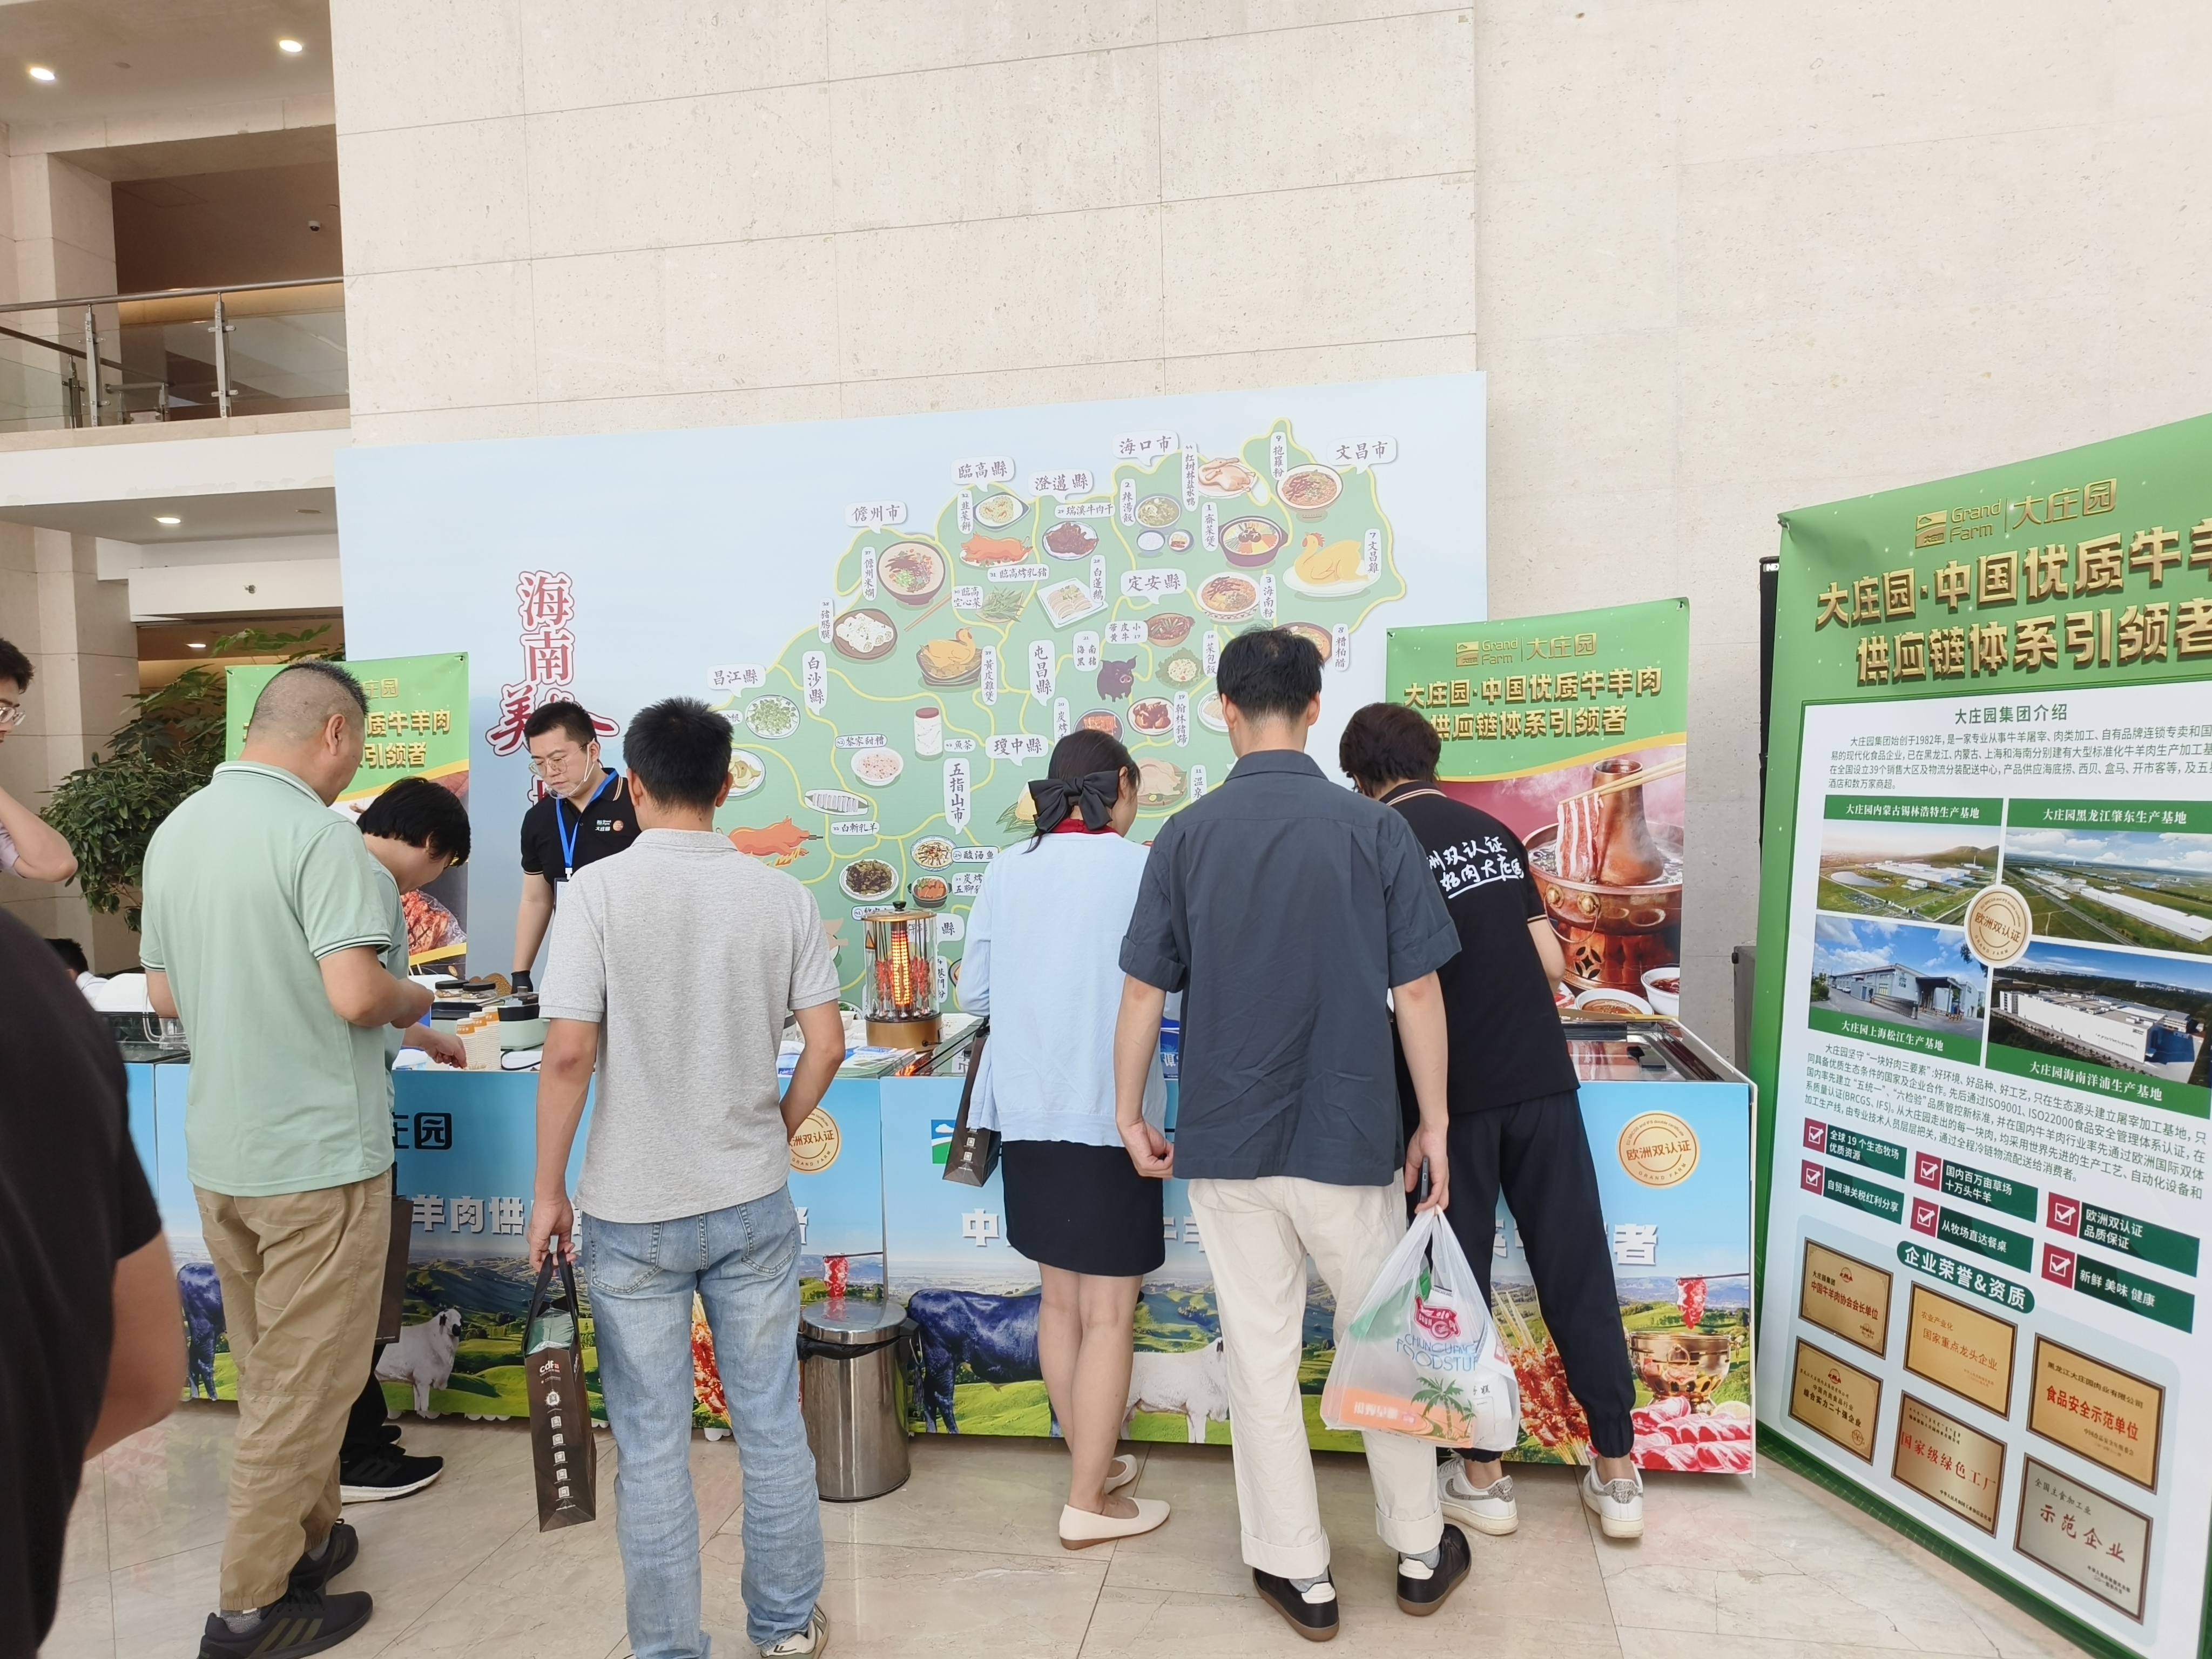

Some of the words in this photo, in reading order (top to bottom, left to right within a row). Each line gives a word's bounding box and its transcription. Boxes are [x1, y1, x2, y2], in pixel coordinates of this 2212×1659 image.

[1118, 436, 1172, 454] 海口市
[1336, 441, 1388, 461] 文昌市
[958, 460, 1008, 480] 臨高縣
[1273, 444, 1286, 478] 抱羅粉
[1184, 453, 1196, 507] 红树林盐水鸭
[851, 504, 901, 524] 儋州市
[1066, 504, 1114, 517] 瑞溪牛肉干
[1122, 491, 1135, 524] 辣湯飯
[1951, 497, 2001, 524] Grand
[2012, 477, 2118, 530] 大庄园
[1950, 523, 1993, 543] Farm
[1367, 542, 1380, 574] 文昌雞
[1128, 573, 1181, 592] 定安縣
[953, 597, 981, 609] 空心菜
[1262, 585, 1274, 619] 海南粉
[522, 576, 570, 682] 海南
[1076, 644, 1097, 656] 海南
[1335, 636, 1347, 669] 糟粕醋
[1481, 637, 1518, 652] Grand
[1526, 632, 1597, 661] 大庄园
[1034, 645, 1052, 696] 屯昌縣
[1481, 654, 1513, 665] Farm
[713, 669, 758, 685] 昌江縣
[807, 656, 825, 704] 白沙縣
[1403, 666, 1662, 709] 大庄园·中国优质牛羊肉
[1954, 703, 2068, 725] 大庄园集团介绍
[359, 741, 427, 767] 引领者
[954, 739, 973, 751] 魚茶
[994, 736, 1042, 756] 瓊中縣
[949, 763, 965, 823] 五指山市
[1828, 778, 1896, 790] 酒店和数万家商超。
[1845, 803, 1980, 819] 大庄园内蒙古锡林浩特生产基地
[2042, 808, 2188, 826] 大庄园黑龙江肇东生产基地
[963, 851, 994, 860] 酸汤鱼
[962, 873, 982, 884] 炭烤
[1974, 912, 2021, 943] 欧洲双认证
[1974, 934, 1990, 954] GRAND
[1841, 1020, 1944, 1051] 大庄园上海松江生产基地
[2029, 1061, 2163, 1102] 大庄园海南洋浦生产基地
[789, 1130, 835, 1147] 洲双认证
[1626, 1139, 1691, 1161] 欧洲双认证
[1829, 1142, 1861, 1162] 优质资源
[1830, 1129, 1846, 1143] 全球
[1847, 1135, 1857, 1145] 19
[1858, 1139, 1899, 1160] 个生态牧场
[791, 1157, 814, 1166] GRAND
[817, 1150, 831, 1164] FARM
[1638, 1171, 1665, 1181] GRAND
[1669, 1163, 1687, 1178] FARM
[1945, 1165, 2013, 1196] 国内百万亩草场
[1945, 1182, 1992, 1204] 十万头牛羊
[1826, 1179, 1899, 1213] 自贸港关税红利分享
[962, 1208, 1000, 1247] 中
[1941, 1219, 2007, 1253] 从牧场直达餐桌
[2085, 1209, 2143, 1238] 欧洲双认证
[1613, 1223, 1658, 1266] 者
[2083, 1226, 2130, 1251] 品质保证
[1812, 1270, 1836, 1287] 大庄园集团
[1904, 1245, 2027, 1311] 企业荣誉&资质
[2079, 1269, 2102, 1287] 新鲜
[2105, 1277, 2128, 1298] 美味
[2130, 1285, 2156, 1307] 健康
[1811, 1280, 1879, 1321] 中国牛羊肉协会会长单位
[1920, 1311, 1954, 1332] 农业产业化
[1923, 1327, 1998, 1372] 国家重点龙头企业
[539, 1360, 554, 1373] cdf
[1812, 1384, 1854, 1412] 中国肉类食品行业
[2047, 1361, 2144, 1409] 黑龙江大庄园肉业有限公司
[1803, 1387, 1862, 1428] 综合实力二十强企业
[2046, 1384, 2139, 1441] 食品安全示范单位
[1900, 1431, 1997, 1491] 国家级绿色工厂
[2034, 1478, 2092, 1516] 全国主食加工业
[2040, 1503, 2126, 1563] 示范企业
